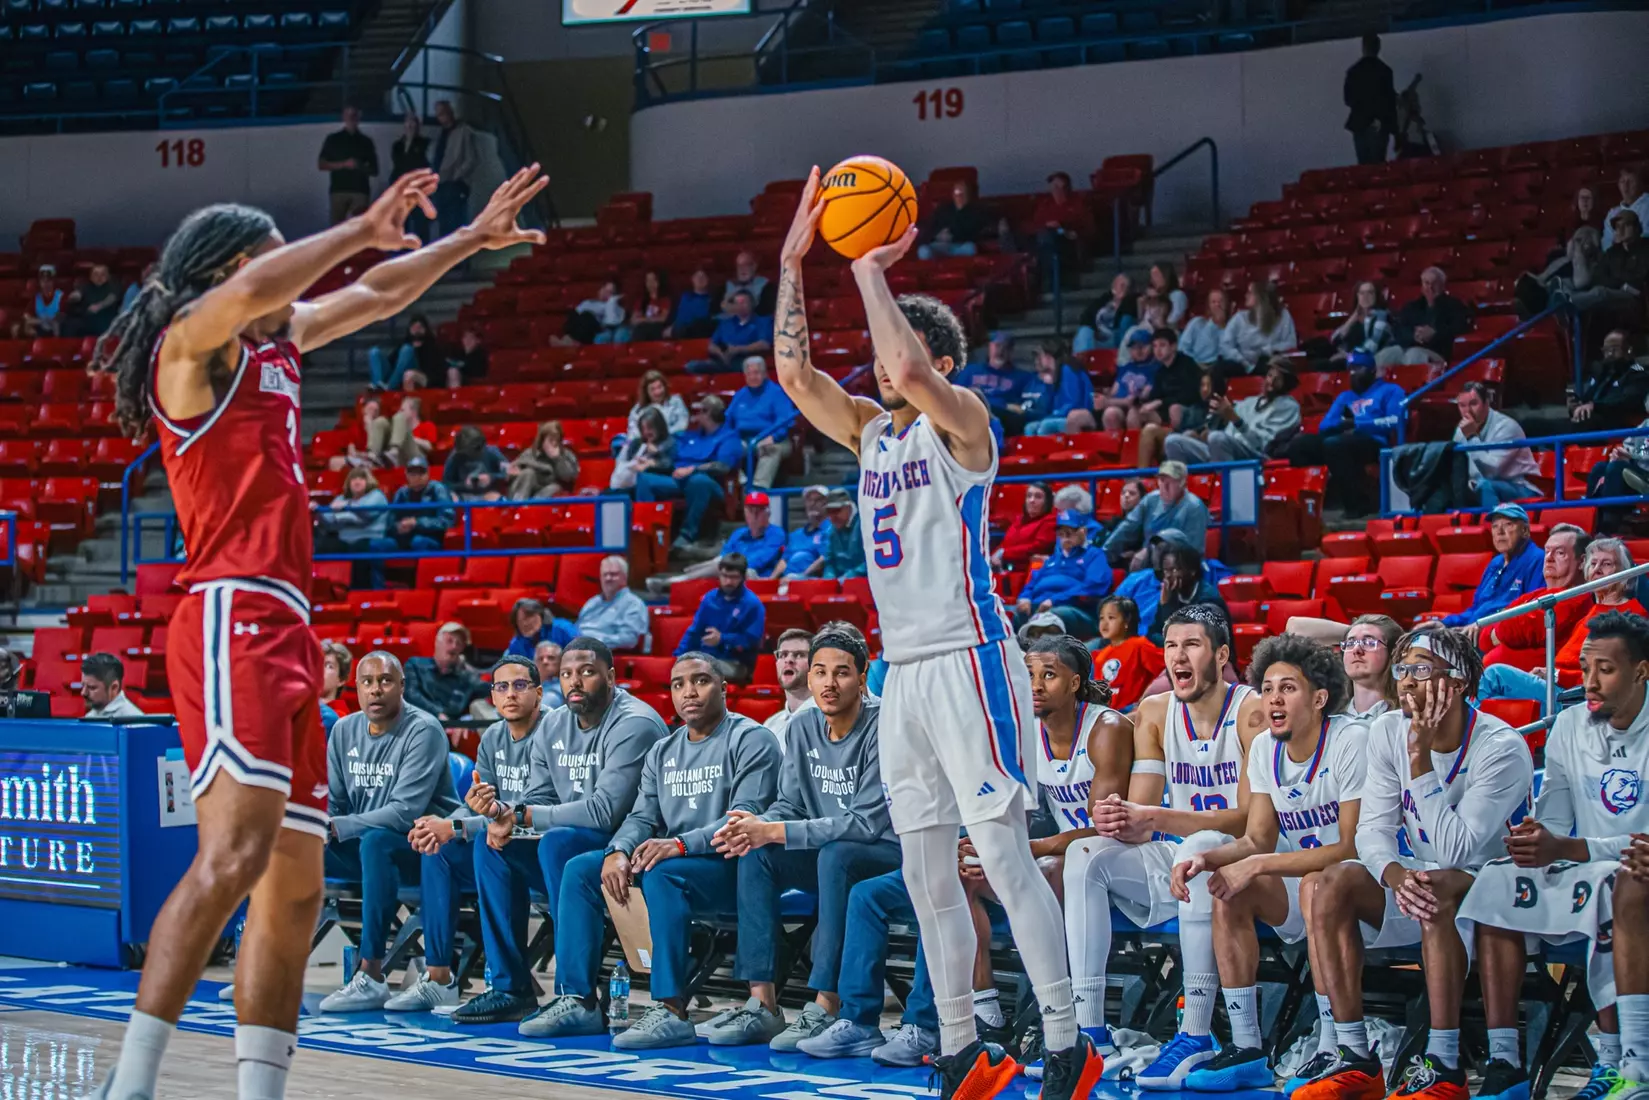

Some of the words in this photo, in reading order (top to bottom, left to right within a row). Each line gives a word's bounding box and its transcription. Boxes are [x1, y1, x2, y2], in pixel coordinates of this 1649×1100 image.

[912, 87, 964, 120] 119
[155, 138, 206, 168] 118
[873, 504, 904, 569] 5
[664, 768, 703, 785] LOUISIANA
[671, 779, 713, 797] BULLDOGS
[0, 836, 95, 873] TURE
